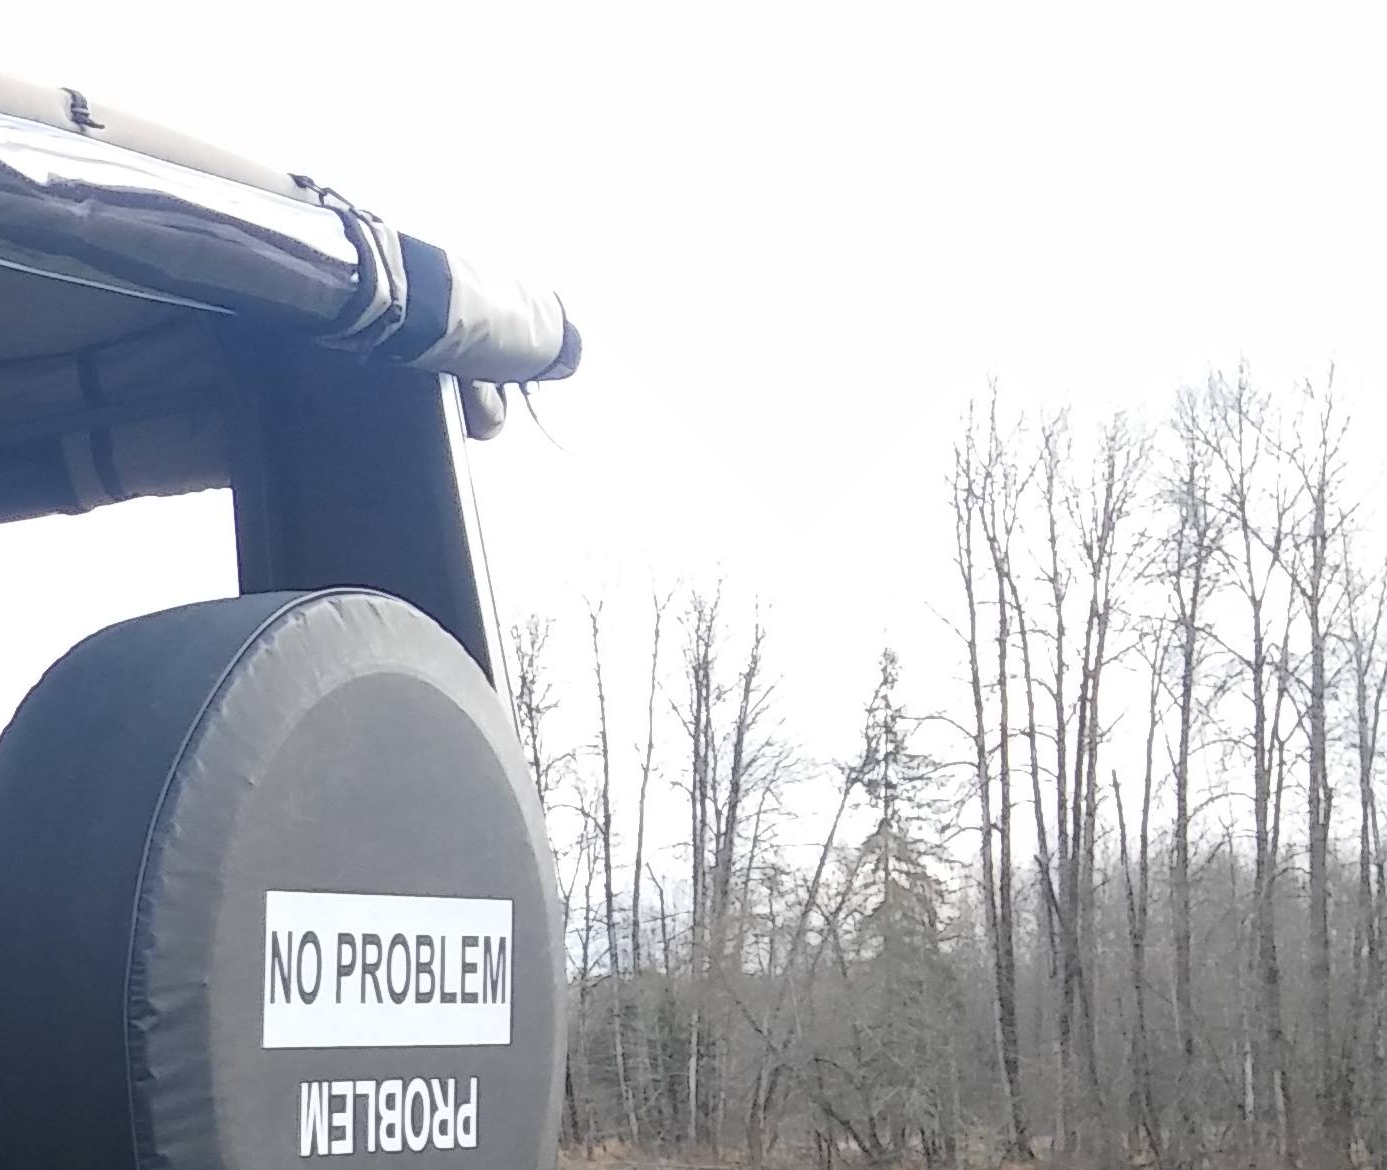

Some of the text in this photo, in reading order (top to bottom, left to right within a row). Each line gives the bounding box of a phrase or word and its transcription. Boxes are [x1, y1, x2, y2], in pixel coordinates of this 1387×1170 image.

[270, 931, 506, 1004] NO PROBLEM
[300, 1077, 477, 1156] PROBLEM
